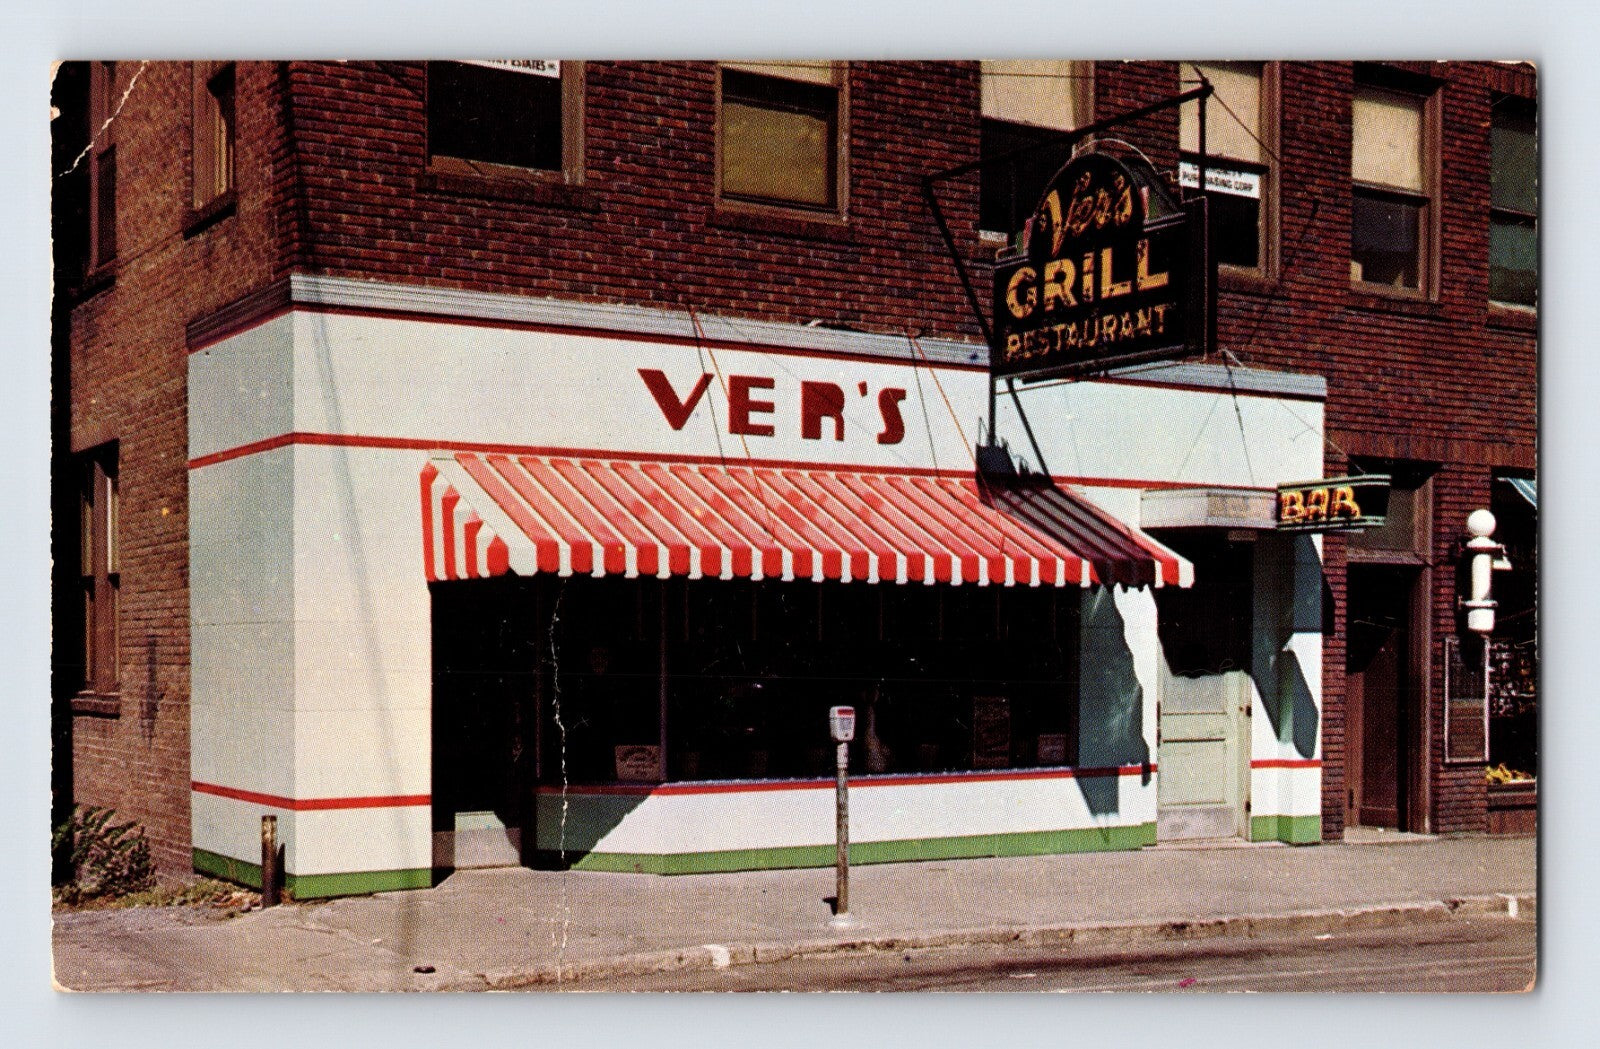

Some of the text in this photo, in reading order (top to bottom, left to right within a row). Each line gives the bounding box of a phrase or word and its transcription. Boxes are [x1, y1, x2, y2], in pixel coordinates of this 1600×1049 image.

[1183, 171, 1232, 188] PURHASING
[1006, 303, 1171, 361] RESTAURANT
[637, 368, 907, 444] VER'S
[1280, 486, 1362, 524] BAR
